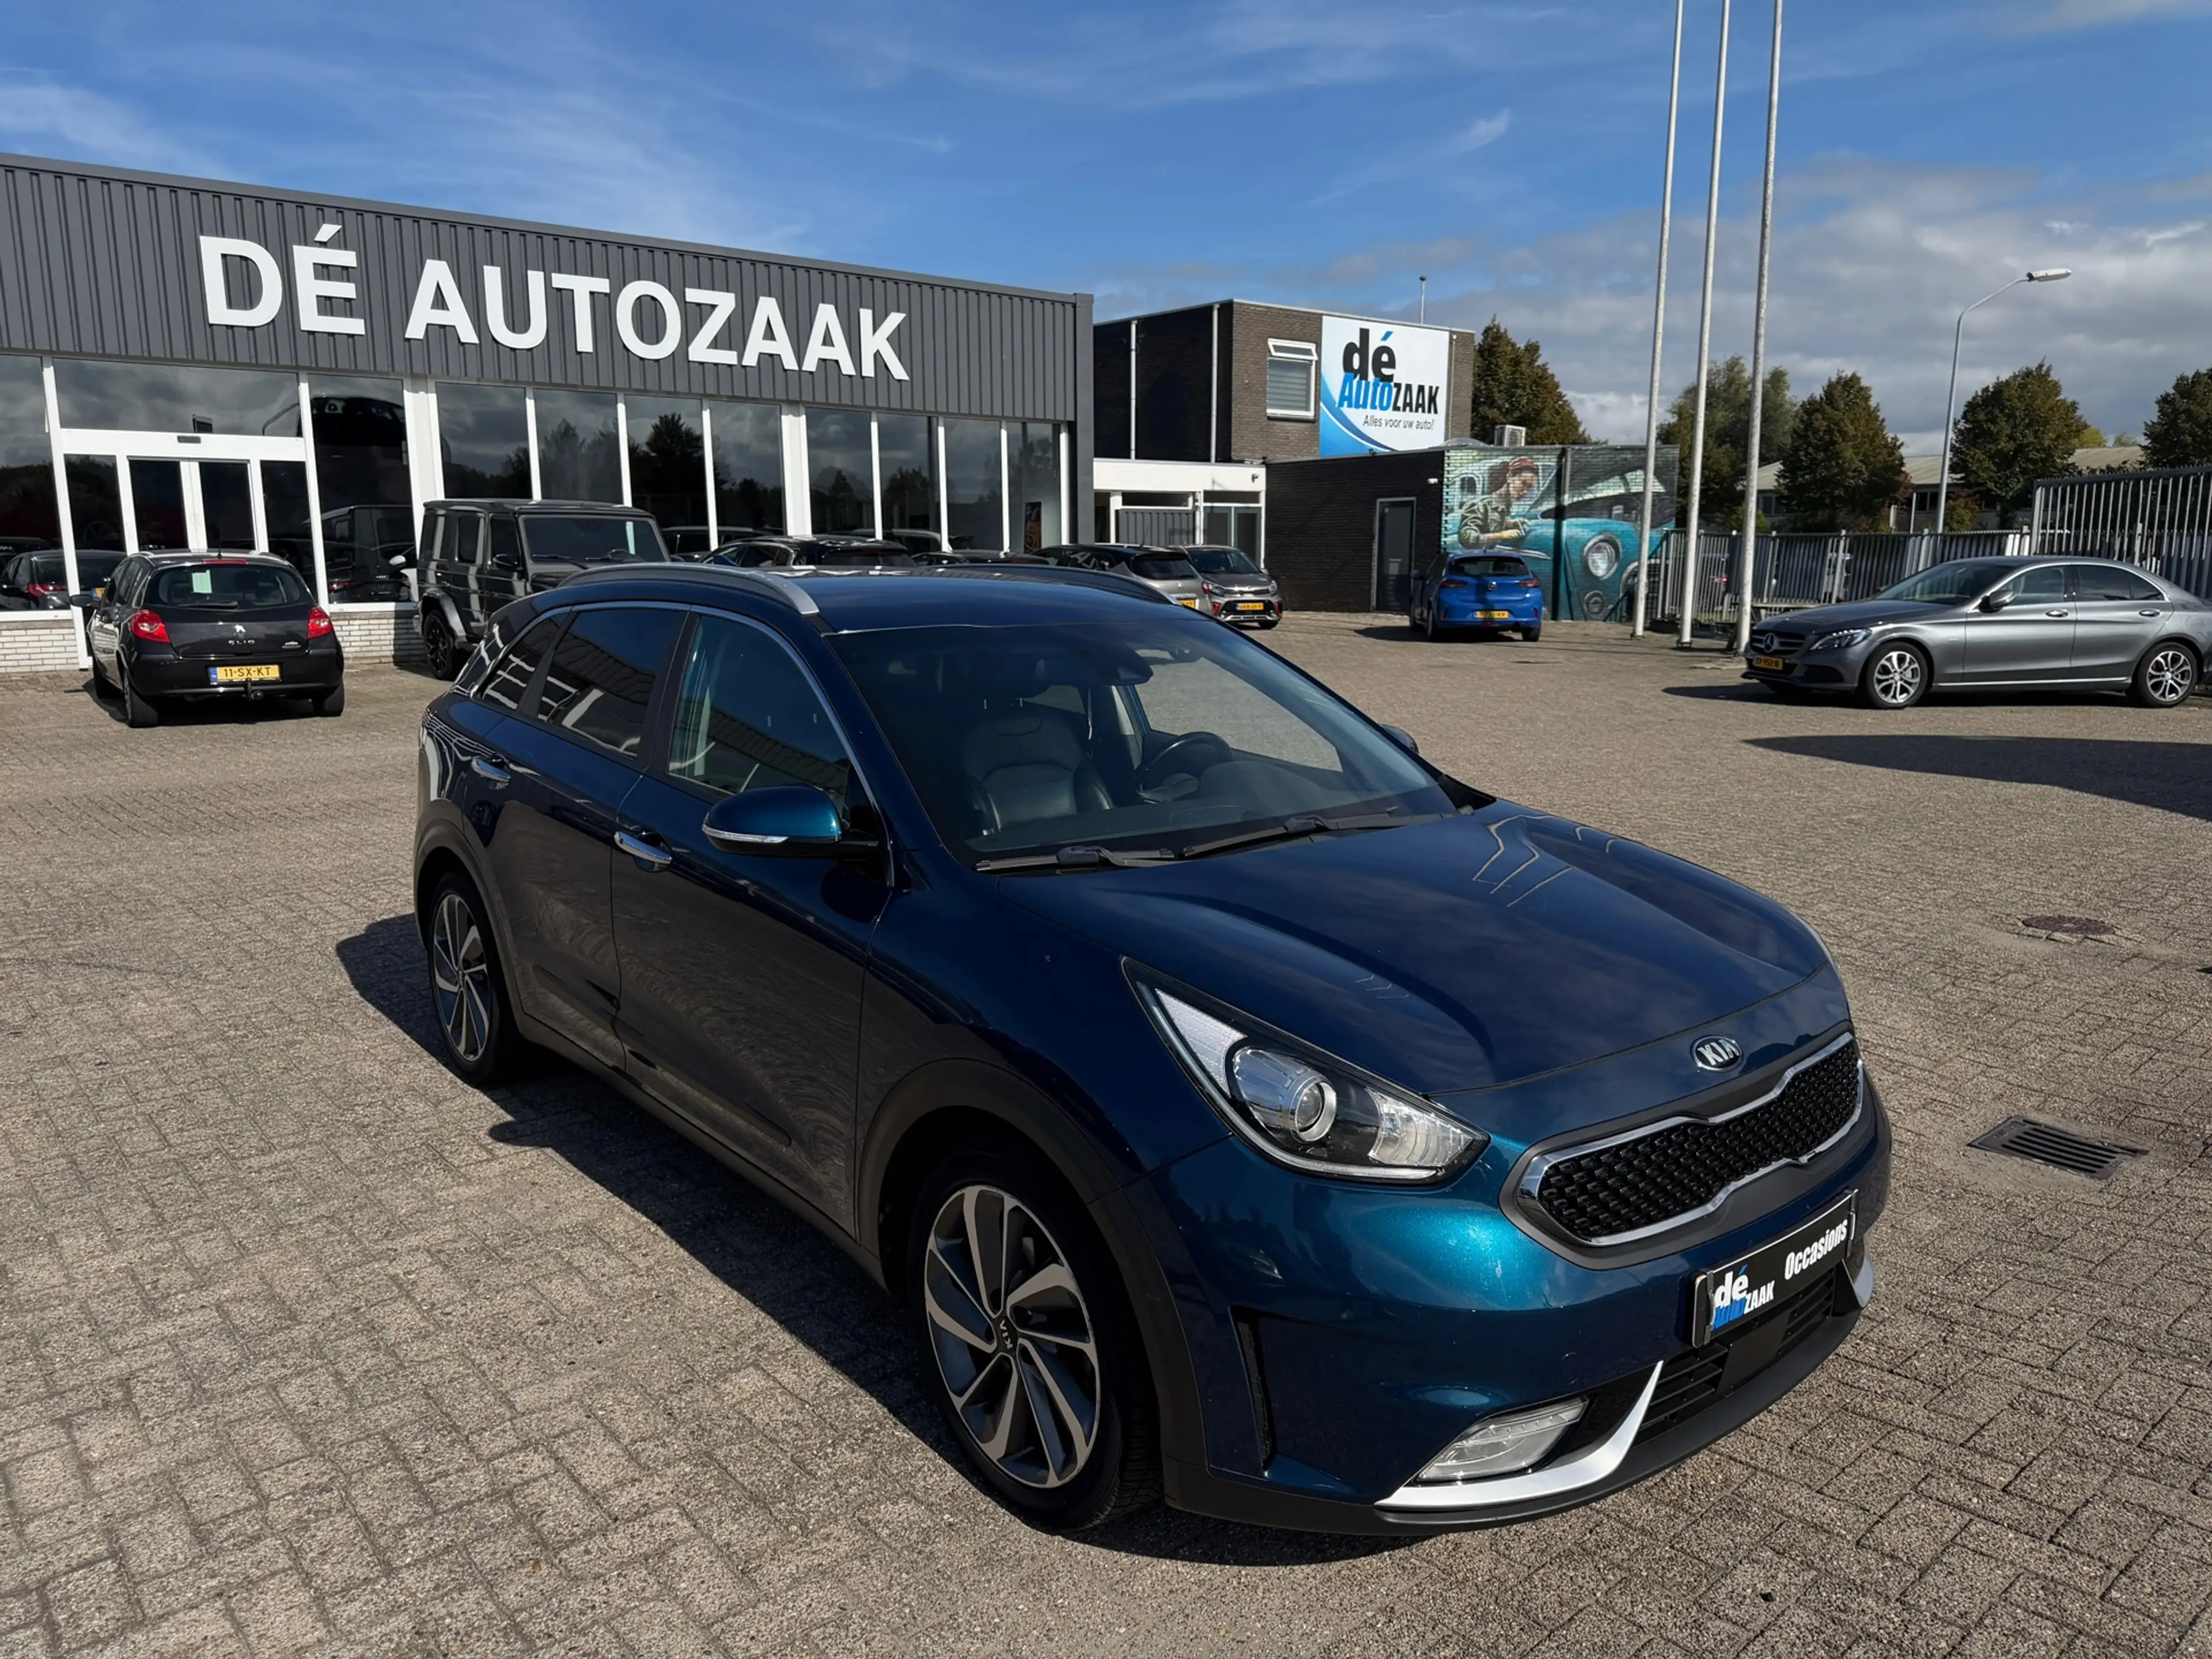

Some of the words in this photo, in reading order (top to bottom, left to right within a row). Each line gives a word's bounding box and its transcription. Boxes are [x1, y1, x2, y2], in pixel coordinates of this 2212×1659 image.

[199, 224, 365, 335] DÉ
[404, 259, 910, 381] AUTOZAAK
[1343, 327, 1396, 382] dé
[1363, 415, 1382, 427] Alles
[1385, 418, 1402, 428] voor
[1403, 419, 1414, 429] uw
[1415, 419, 1434, 430] auto!
[224, 666, 271, 678] 11-SX-KT
[1697, 1039, 1740, 1066] KIA
[1785, 1219, 1848, 1280] Occasions
[1714, 1264, 1749, 1308] dé
